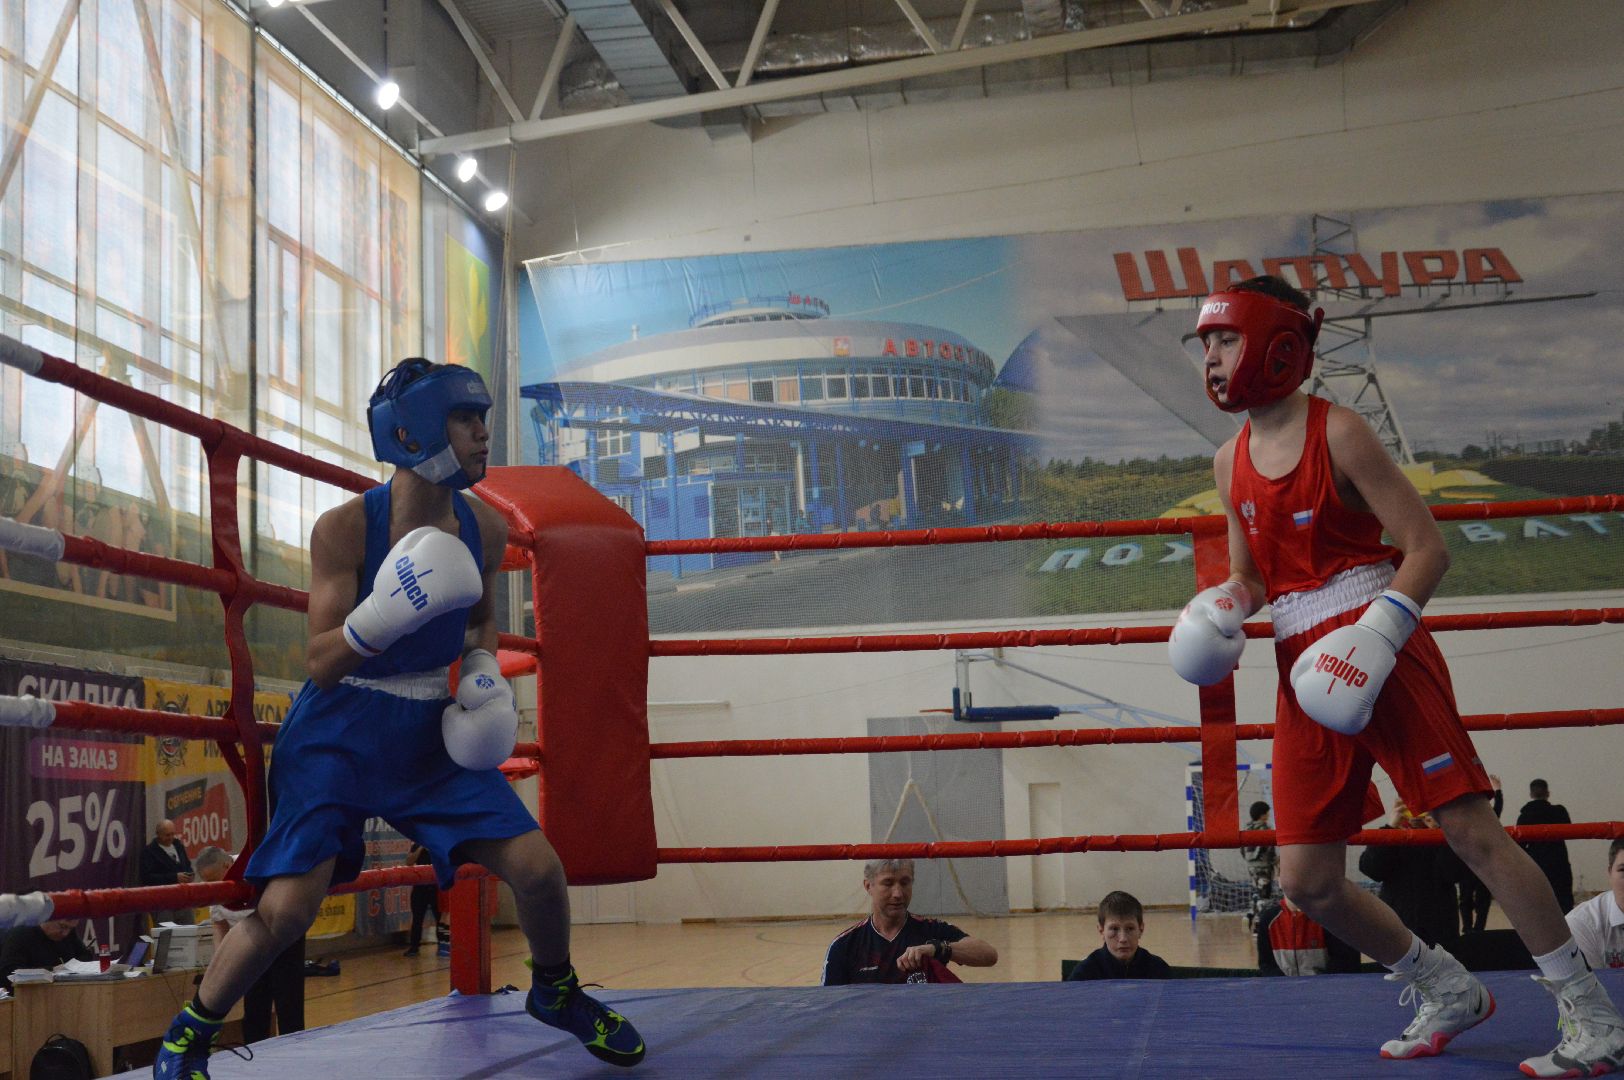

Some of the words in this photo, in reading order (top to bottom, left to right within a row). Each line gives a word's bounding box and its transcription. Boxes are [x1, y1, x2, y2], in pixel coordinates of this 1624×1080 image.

[1113, 246, 1525, 301] ШАТУРА
[395, 555, 429, 612] clinch
[1314, 652, 1369, 688] clinch
[41, 744, 65, 768] НА
[68, 745, 119, 771] ЗАКАЗ
[25, 788, 127, 879] 25%
[183, 812, 220, 848] 5000
